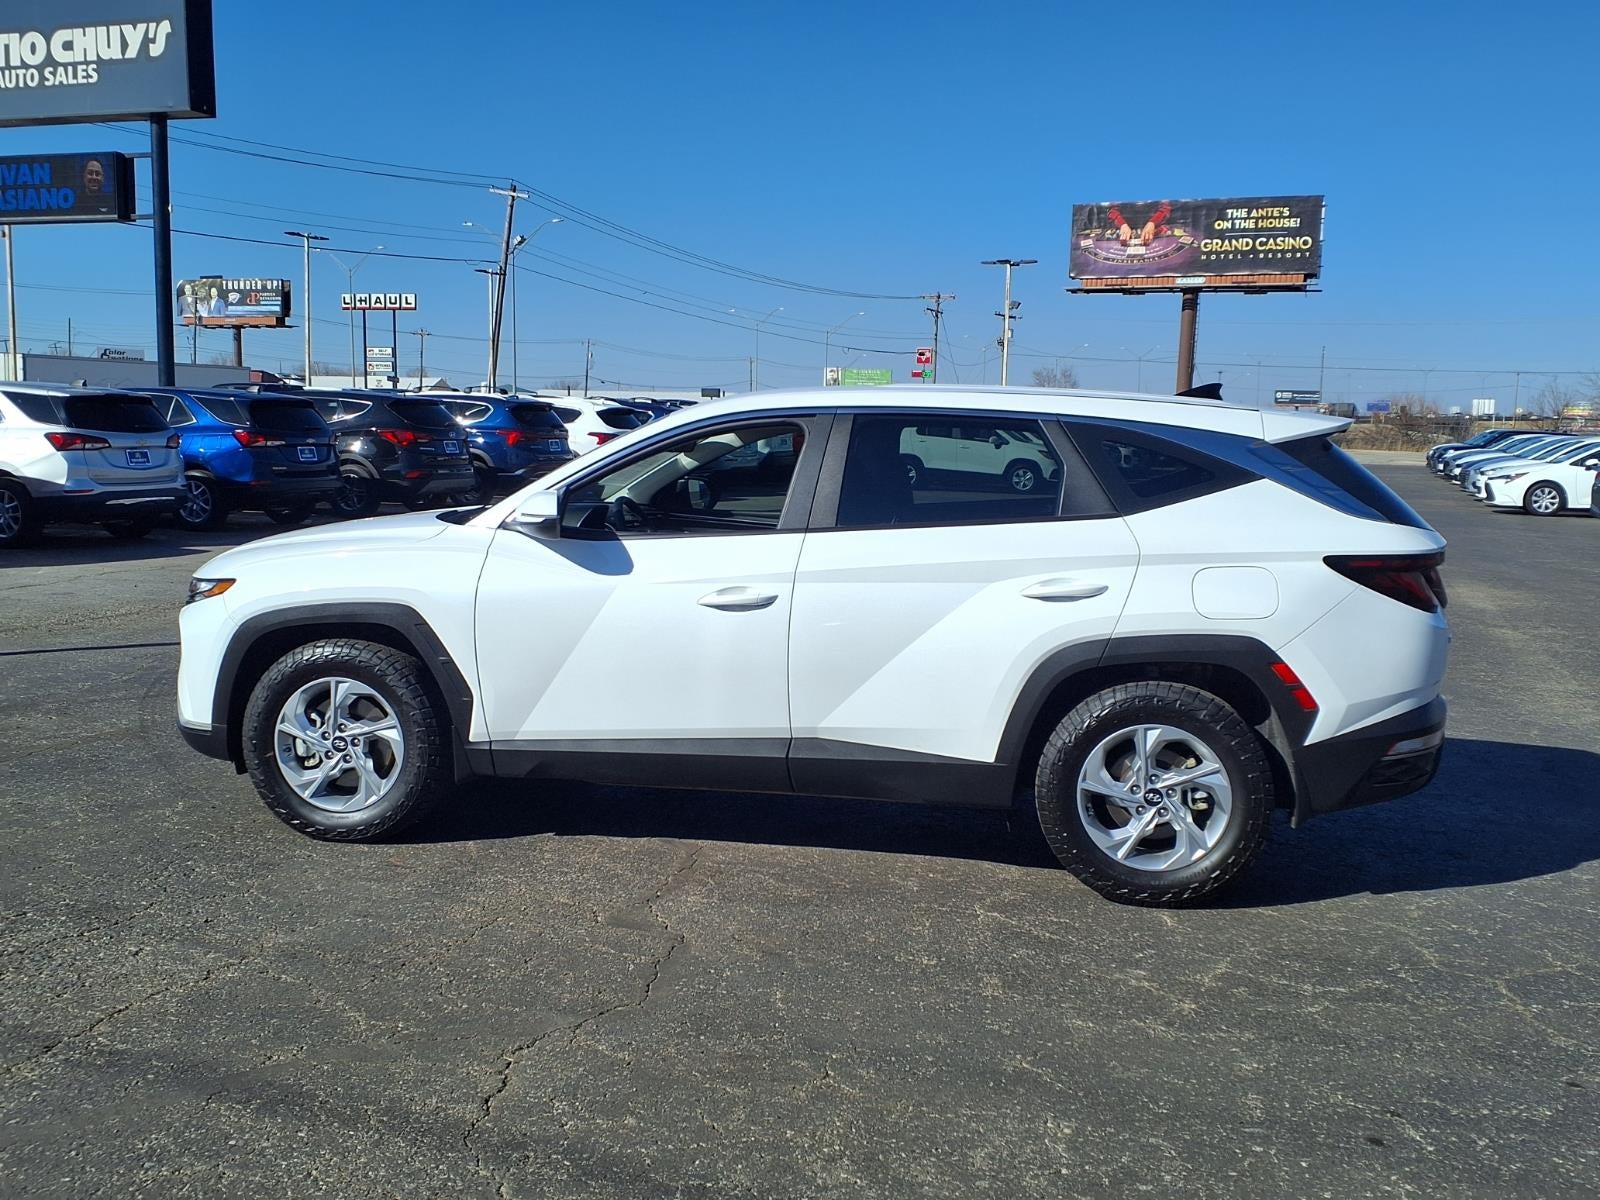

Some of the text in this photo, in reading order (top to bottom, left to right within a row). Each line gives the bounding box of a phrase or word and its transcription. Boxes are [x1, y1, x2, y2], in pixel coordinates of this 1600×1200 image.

[50, 20, 171, 63] CHUY'S
[44, 64, 98, 86] SALES
[1226, 207, 1290, 218] THE ANTE'S
[1214, 218, 1300, 230] ON THE HOUSE!
[1200, 236, 1312, 251] GRAND CASINO
[222, 279, 262, 290] THUNDER
